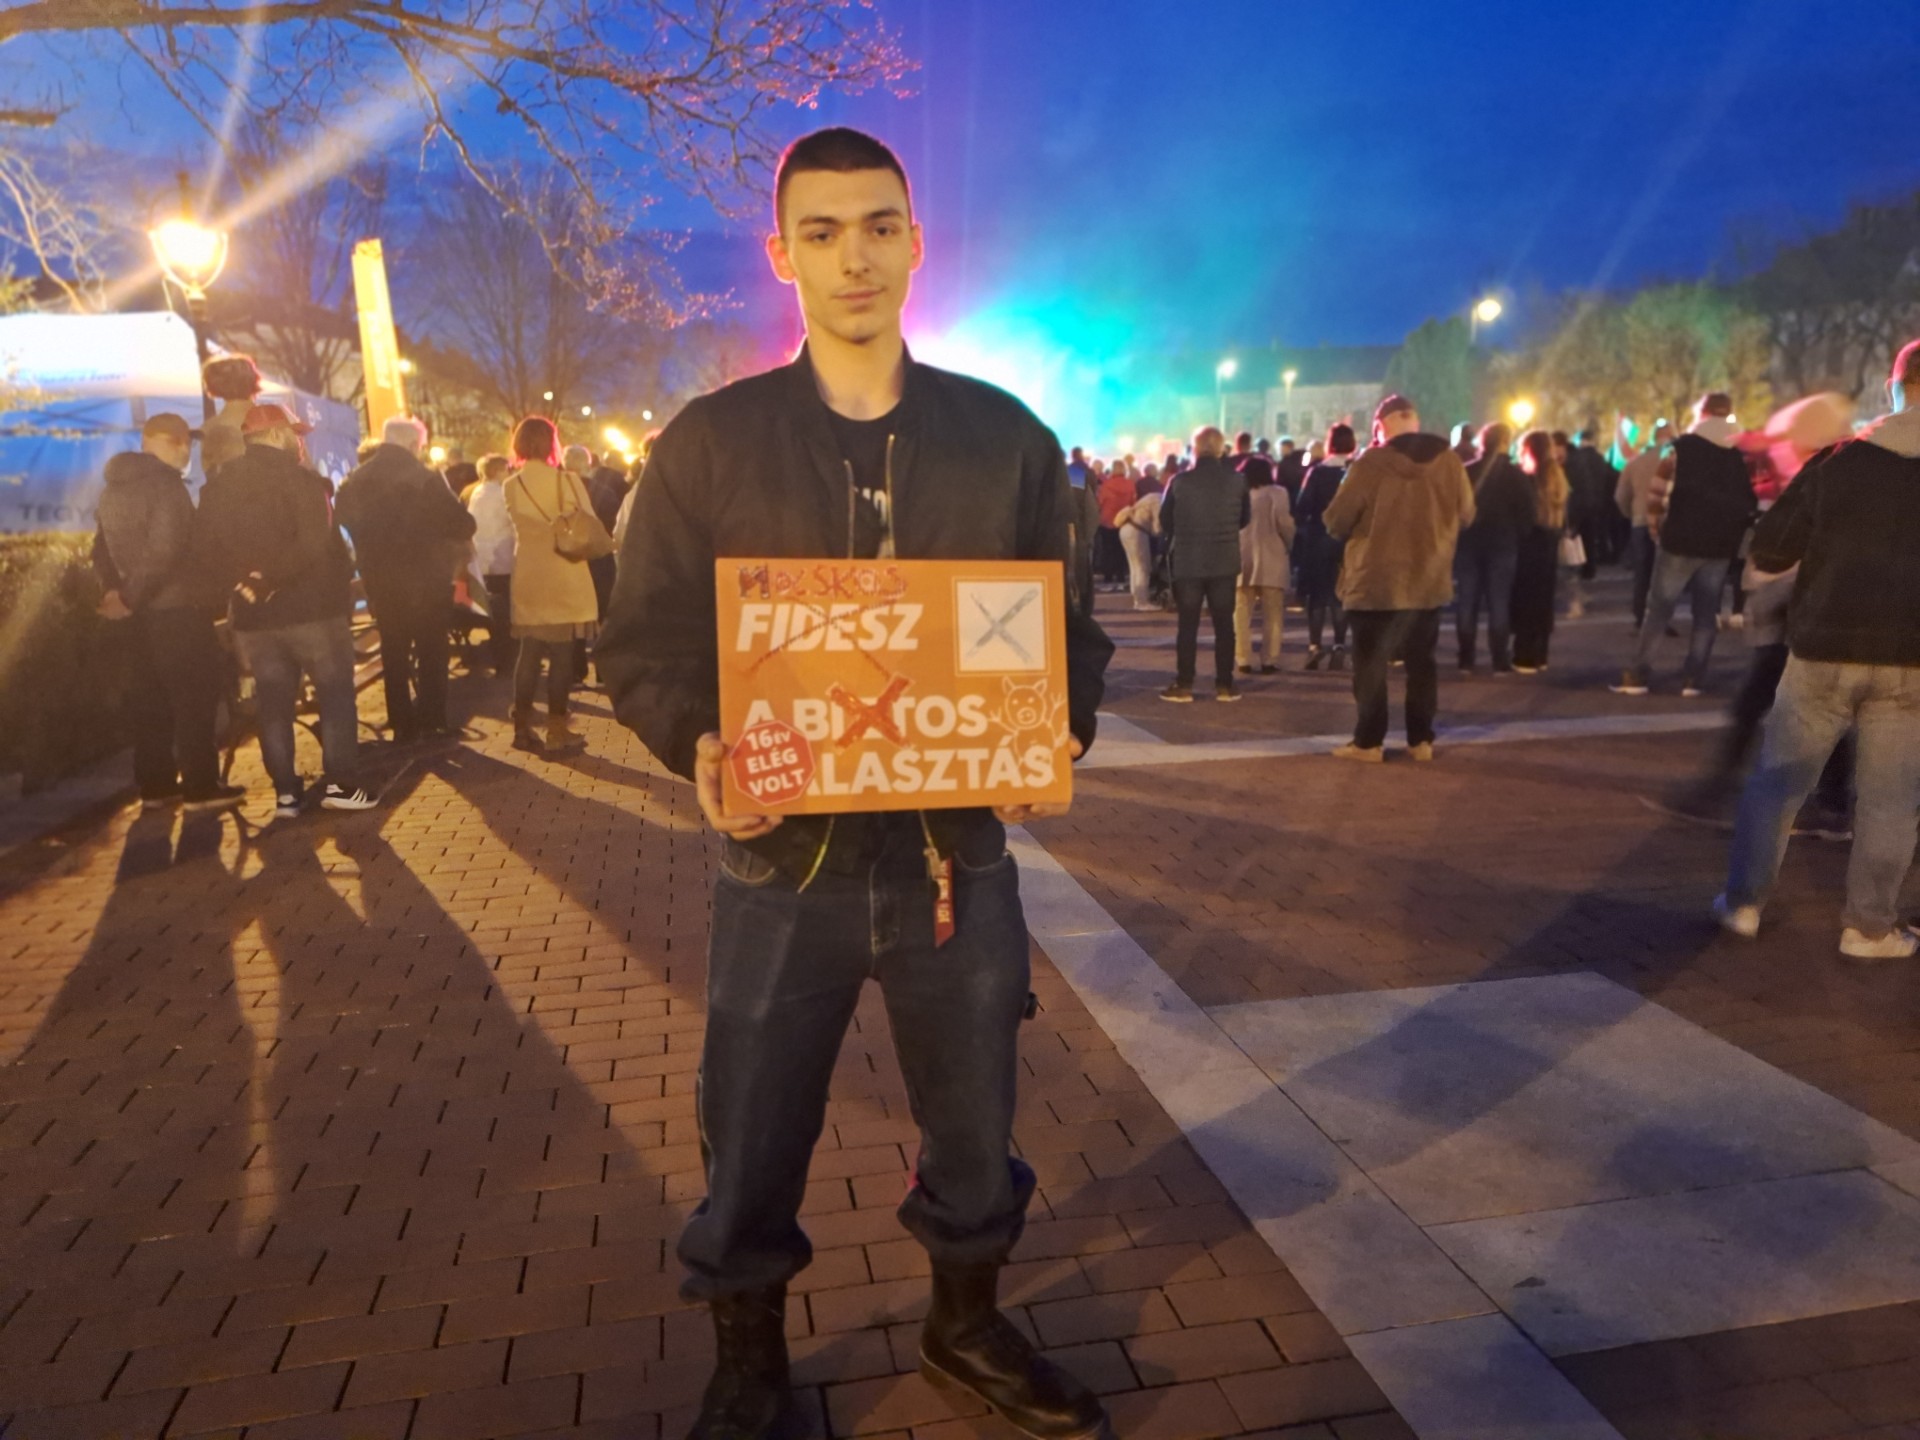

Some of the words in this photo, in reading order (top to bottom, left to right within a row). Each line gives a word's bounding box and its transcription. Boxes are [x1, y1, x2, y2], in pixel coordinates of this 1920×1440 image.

[736, 604, 923, 652] FIDESZ
[743, 700, 775, 731] A
[746, 747, 798, 775] ELÉG
[748, 768, 805, 797] VOLT
